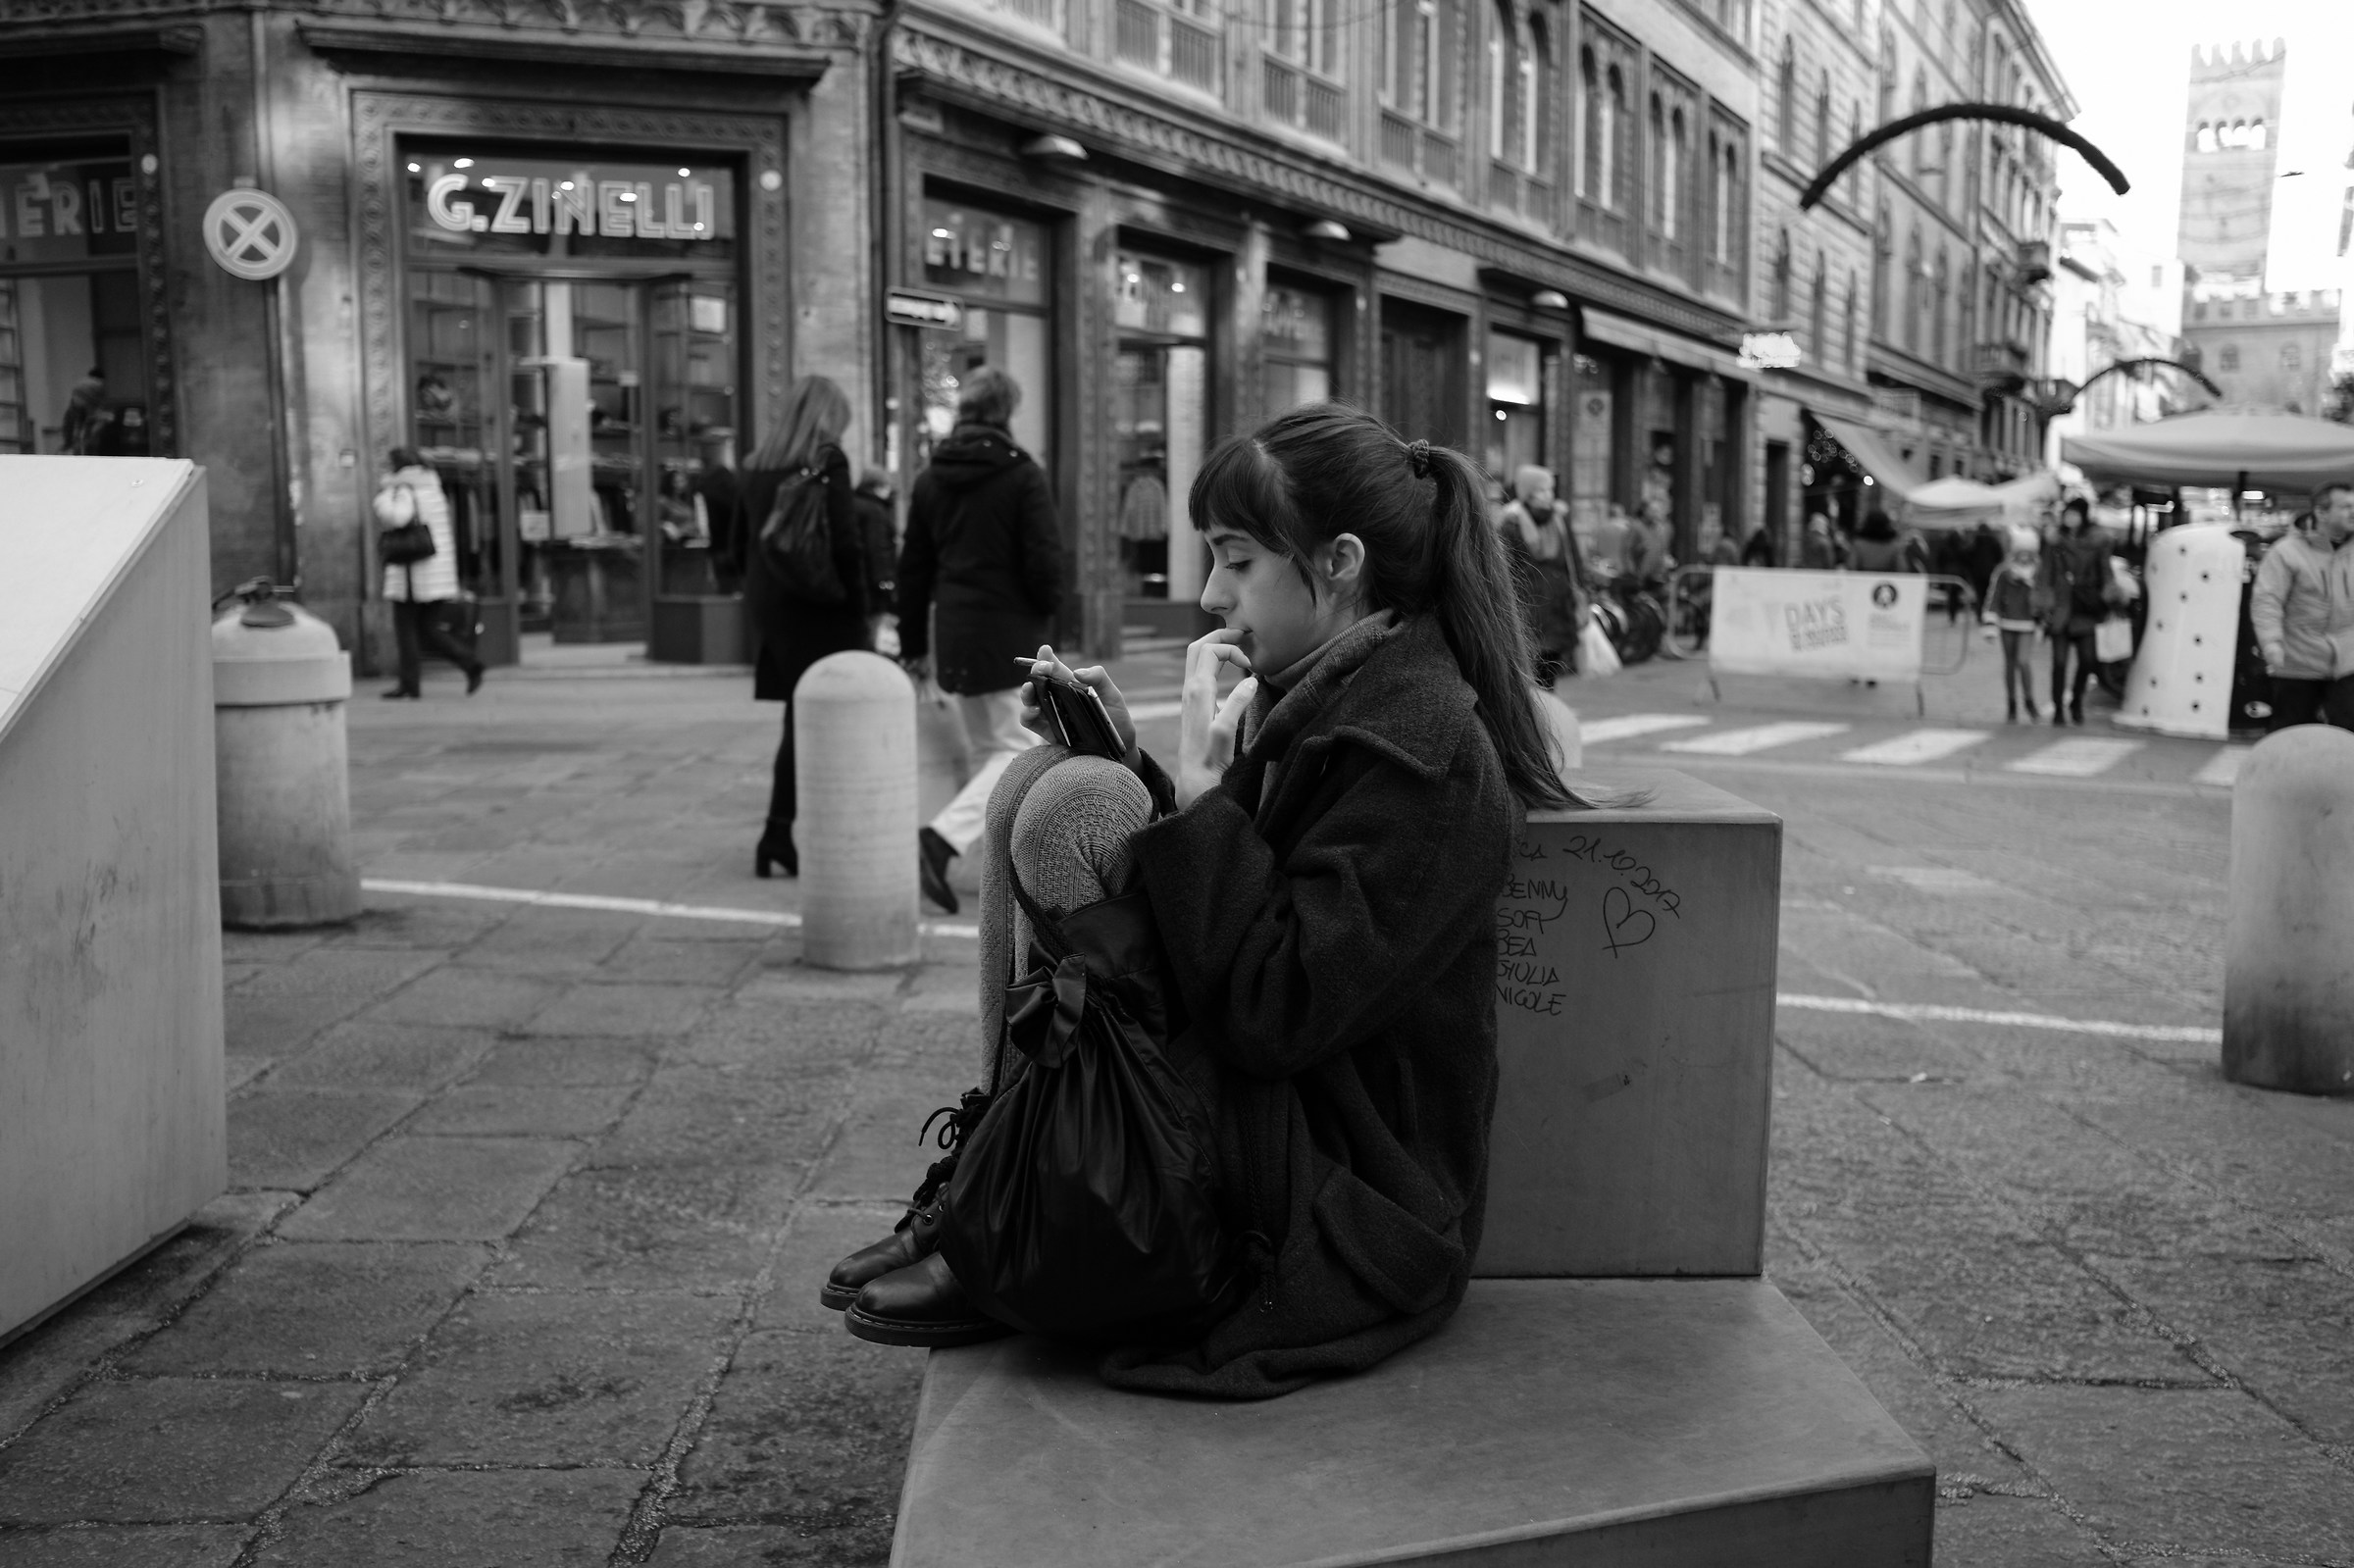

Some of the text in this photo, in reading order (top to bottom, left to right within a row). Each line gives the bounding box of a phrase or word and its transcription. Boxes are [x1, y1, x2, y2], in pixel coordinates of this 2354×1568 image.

[0, 177, 137, 238] ERIE
[428, 173, 715, 240] G.ZINELLI
[1517, 841, 1548, 861] CA
[1502, 873, 1568, 909] BENNY
[1497, 929, 1537, 957] BEA
[1494, 984, 1567, 1016] NICOLE
